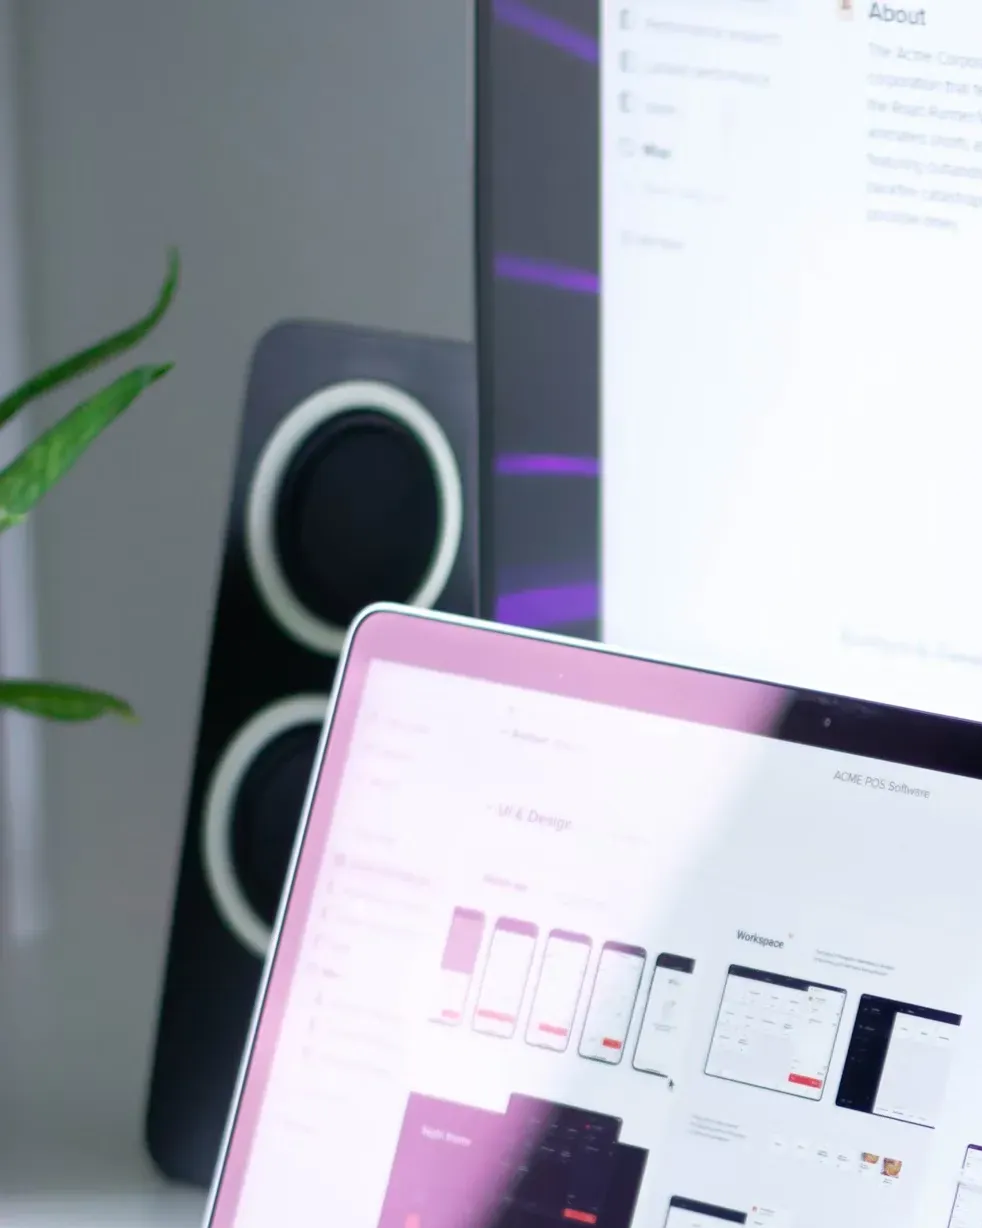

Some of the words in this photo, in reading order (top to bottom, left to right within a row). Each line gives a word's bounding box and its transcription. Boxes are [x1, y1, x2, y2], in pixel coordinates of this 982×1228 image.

[868, 1, 927, 26] About
[833, 770, 863, 786] ACME
[865, 776, 886, 790] POS
[888, 781, 931, 799] Software
[736, 929, 785, 949] Workspace
